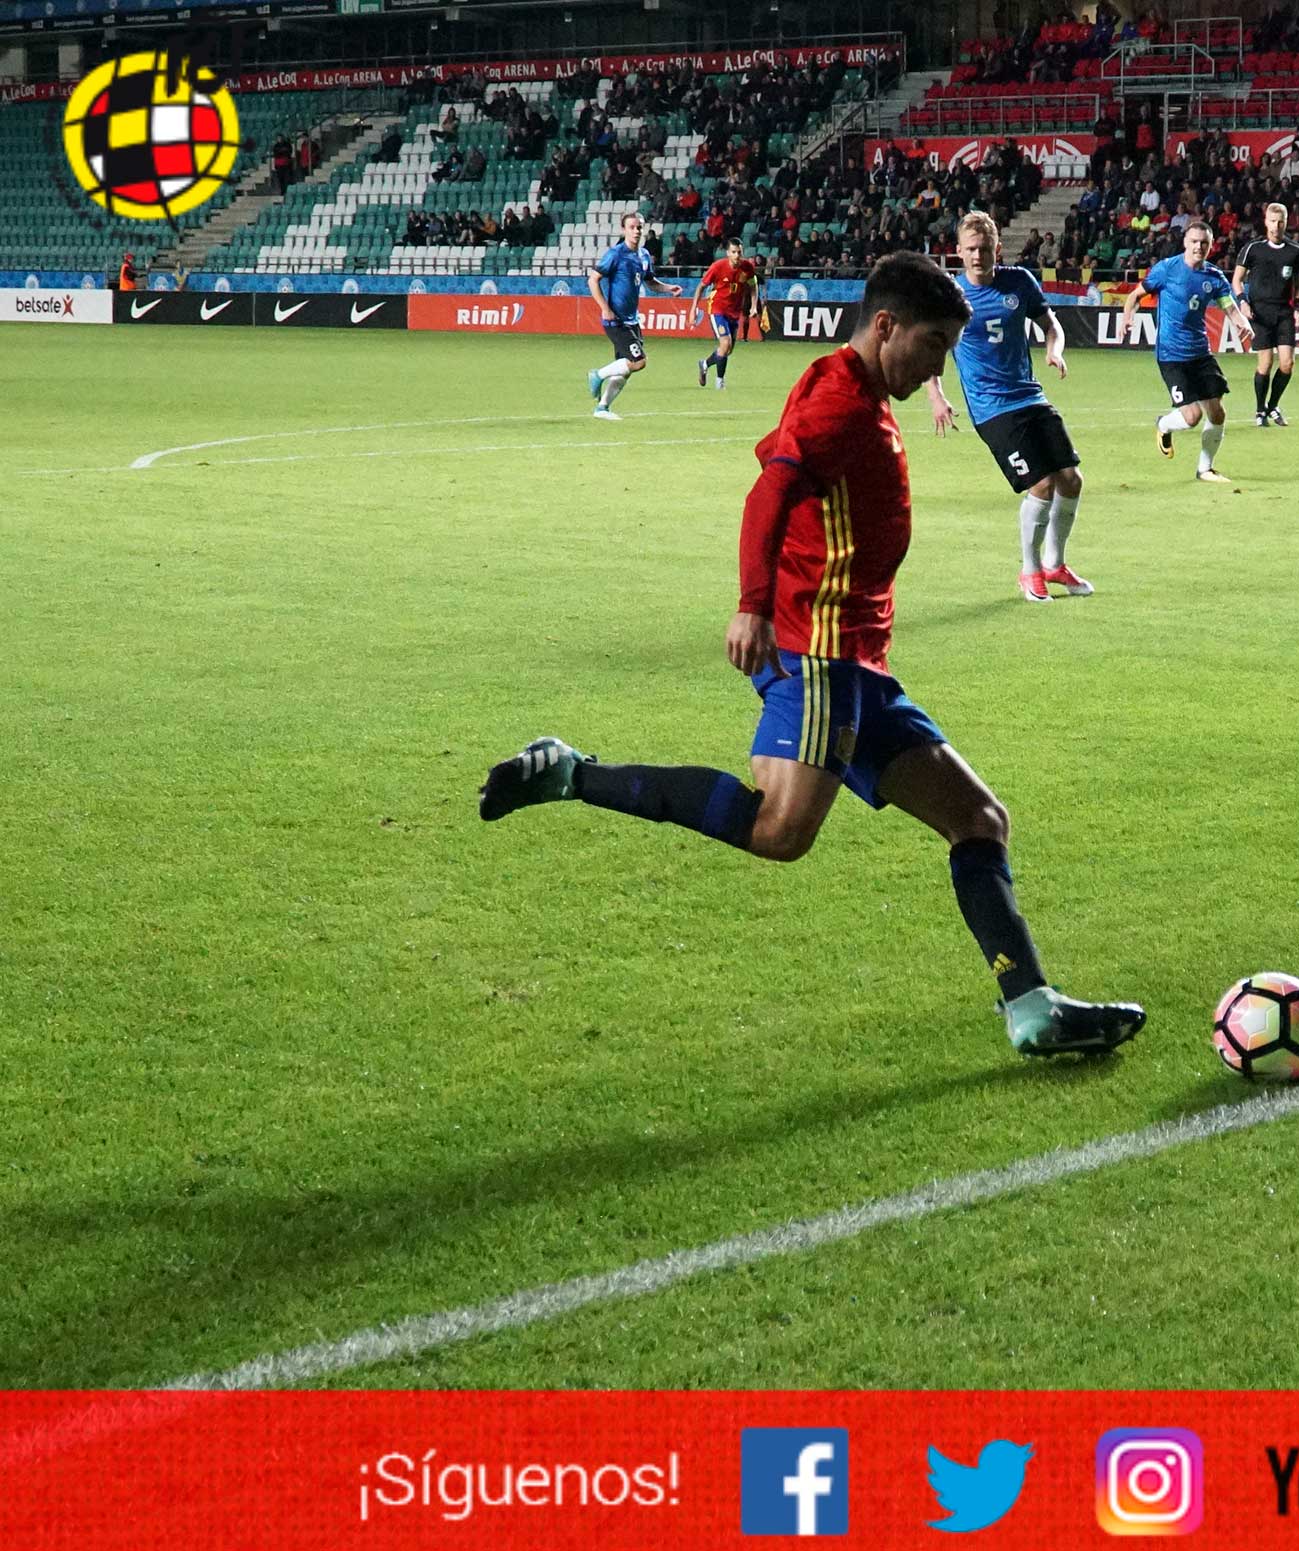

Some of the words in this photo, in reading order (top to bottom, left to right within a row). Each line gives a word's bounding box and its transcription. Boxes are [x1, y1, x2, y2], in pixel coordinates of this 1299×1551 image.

[353, 70, 383, 84] ARENA
[504, 63, 537, 77] ARENA
[16, 296, 62, 313] betsafe
[1188, 294, 1200, 311] 6
[783, 306, 843, 337] LHV
[985, 318, 1004, 343] 5
[630, 342, 642, 359] 8
[1171, 385, 1184, 404] 6
[1007, 450, 1030, 476] 5
